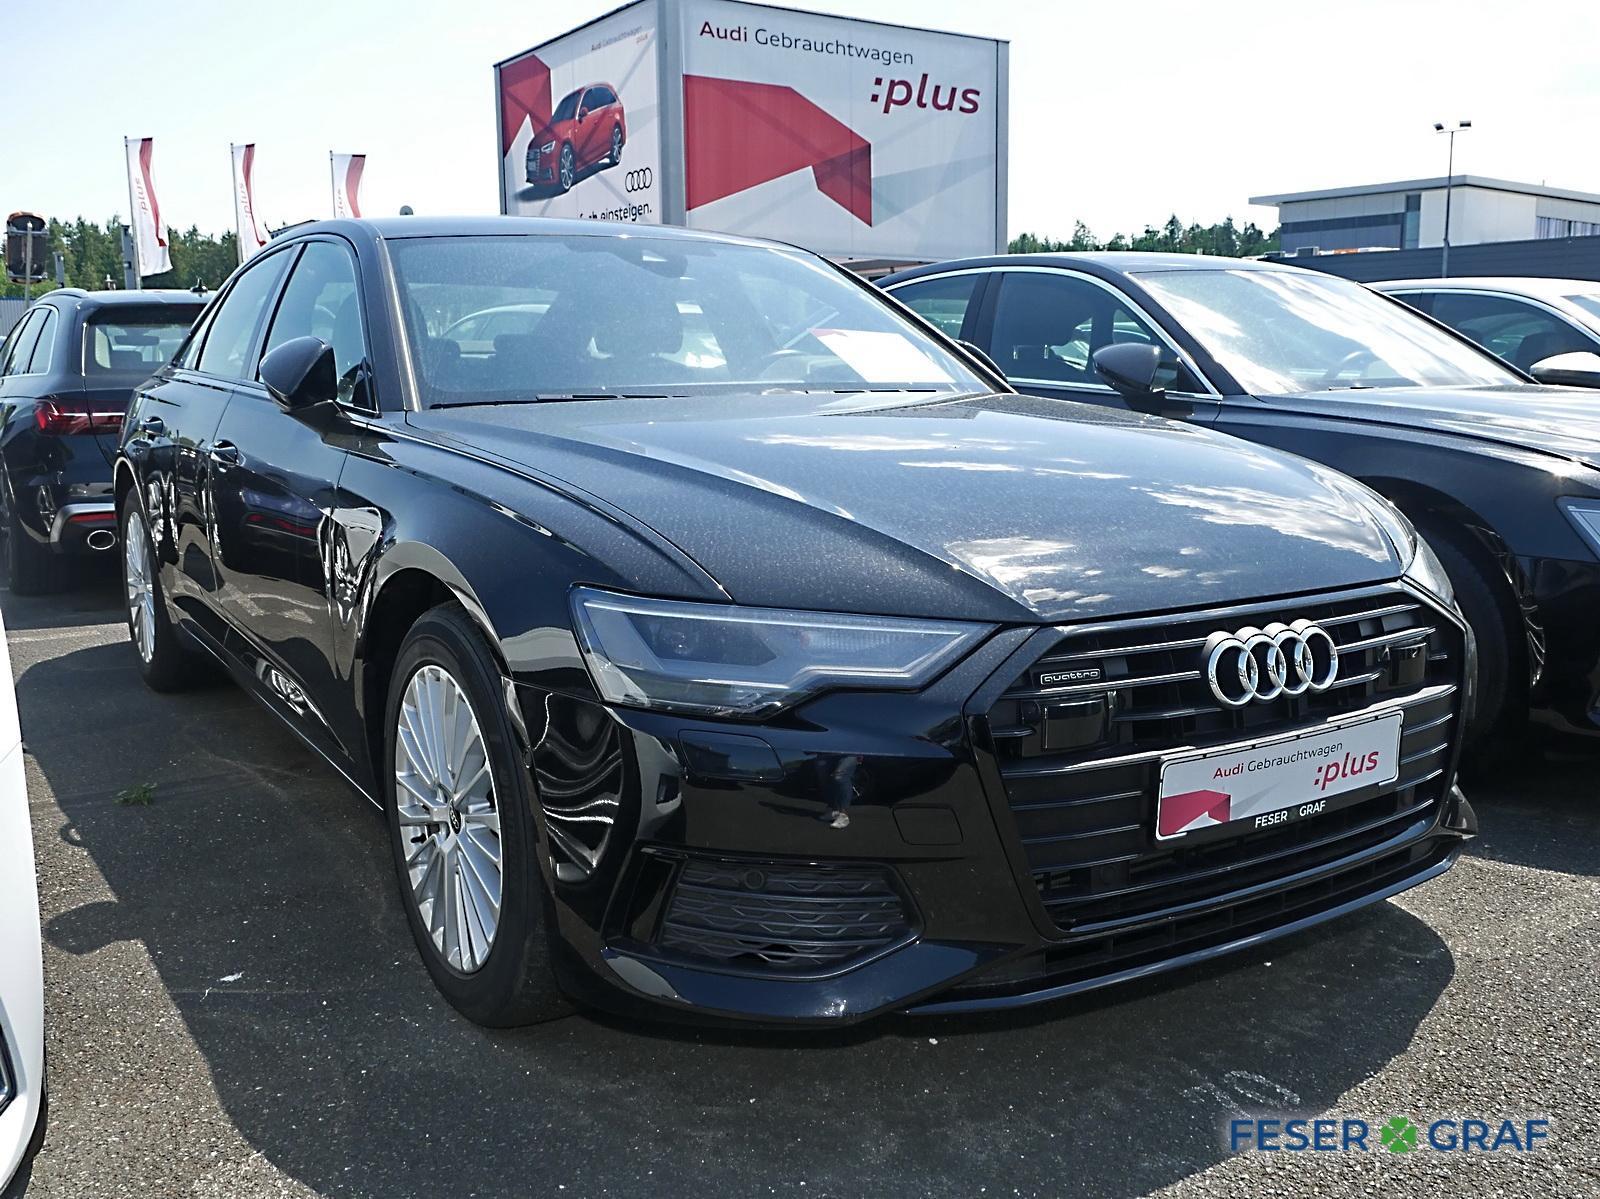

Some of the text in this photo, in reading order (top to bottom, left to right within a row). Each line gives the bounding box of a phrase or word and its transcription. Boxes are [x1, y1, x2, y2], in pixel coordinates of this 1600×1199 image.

[700, 21, 914, 65] Audi Gebrauchtwagen
[870, 73, 981, 114] :plus
[1044, 671, 1098, 683] quattro
[1213, 741, 1343, 779] Audi Gebrauchtwagen
[1313, 751, 1379, 790] :plus
[1255, 801, 1326, 828] FESER GRAF
